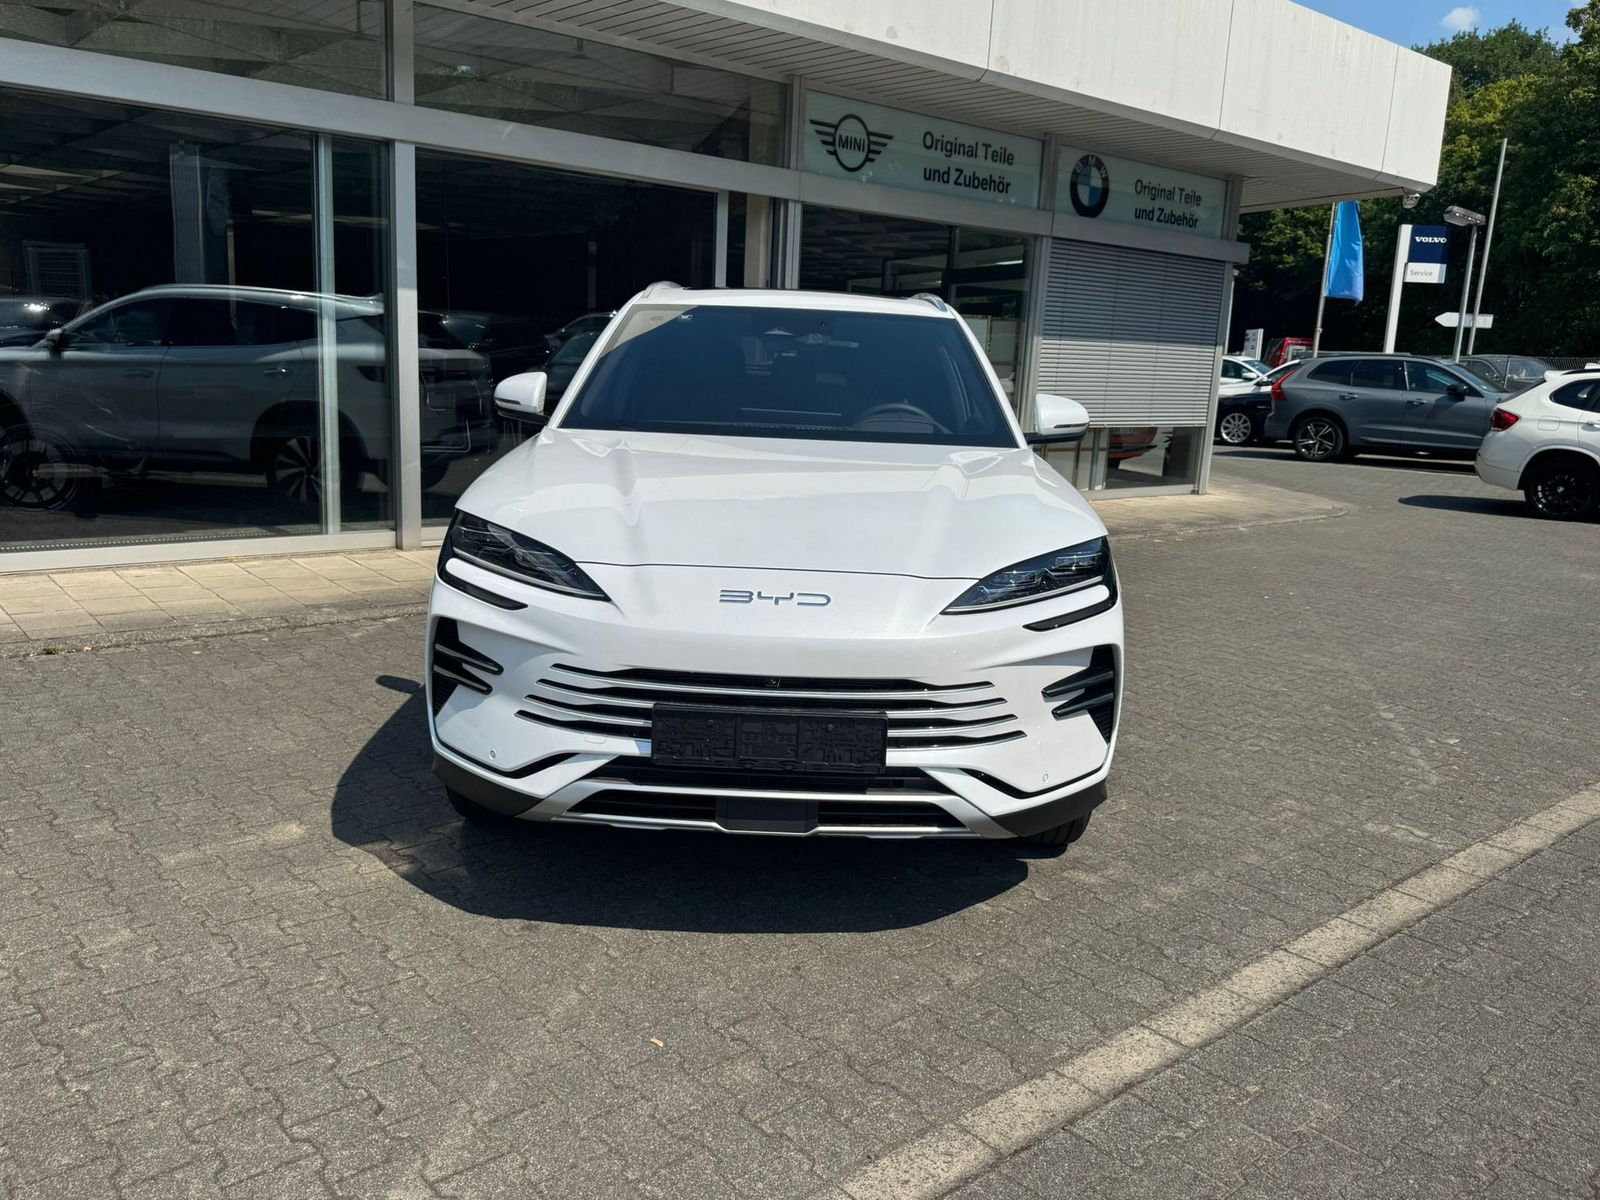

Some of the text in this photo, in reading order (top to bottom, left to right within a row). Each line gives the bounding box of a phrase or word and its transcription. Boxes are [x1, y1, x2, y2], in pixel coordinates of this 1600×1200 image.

[838, 134, 866, 153] MINI
[922, 131, 1015, 166] Original Teile
[923, 166, 1011, 195] und Zubehör
[1134, 179, 1203, 207] Original Teile
[1134, 207, 1199, 229] und Zubehör
[1409, 269, 1433, 277] Service
[719, 589, 832, 606] BYD
